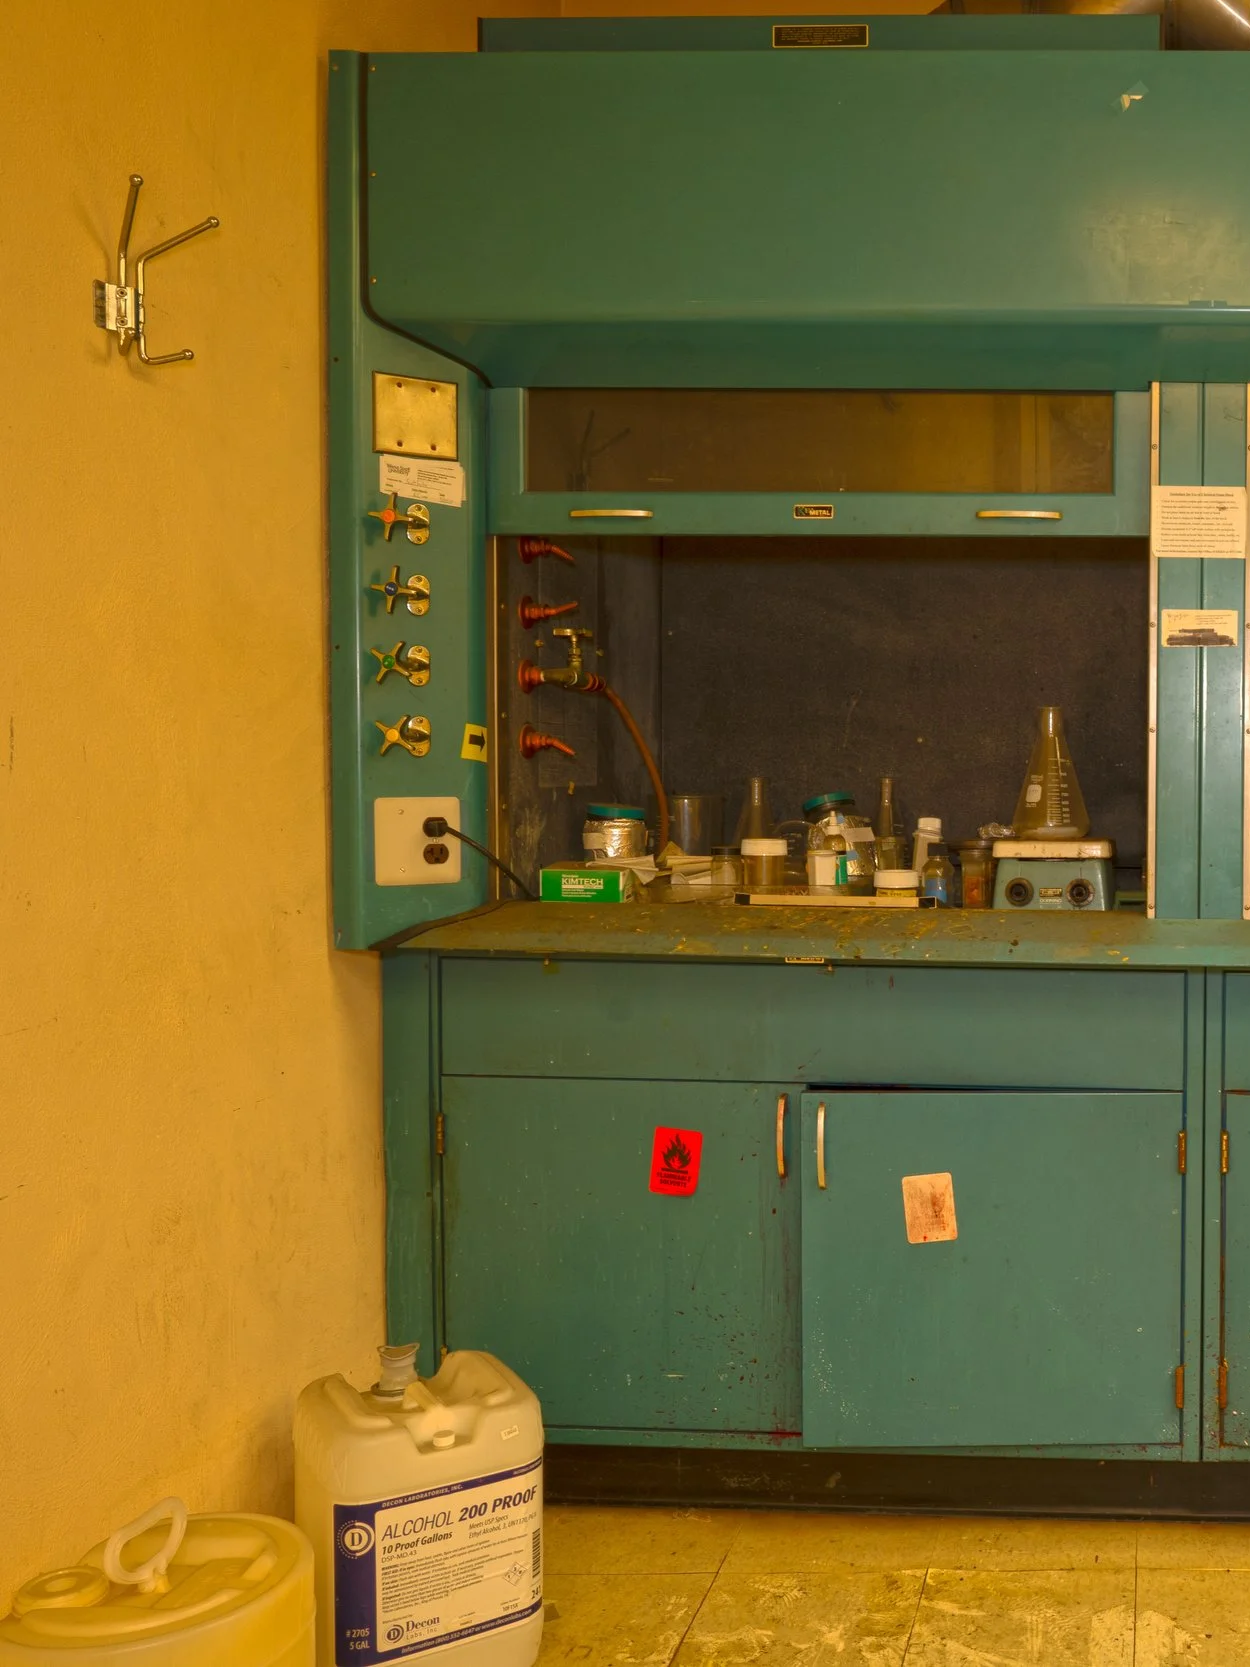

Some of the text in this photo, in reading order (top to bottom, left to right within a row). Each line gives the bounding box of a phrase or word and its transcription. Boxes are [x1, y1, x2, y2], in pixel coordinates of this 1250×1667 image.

[381, 1484, 538, 1542] ALCOHOL 200 PROOF
[382, 1531, 453, 1555] 10 Proof Gallons
[406, 1616, 440, 1632] Decon
[352, 1628, 370, 1638] 2705
[349, 1640, 370, 1650] 5 GAL
